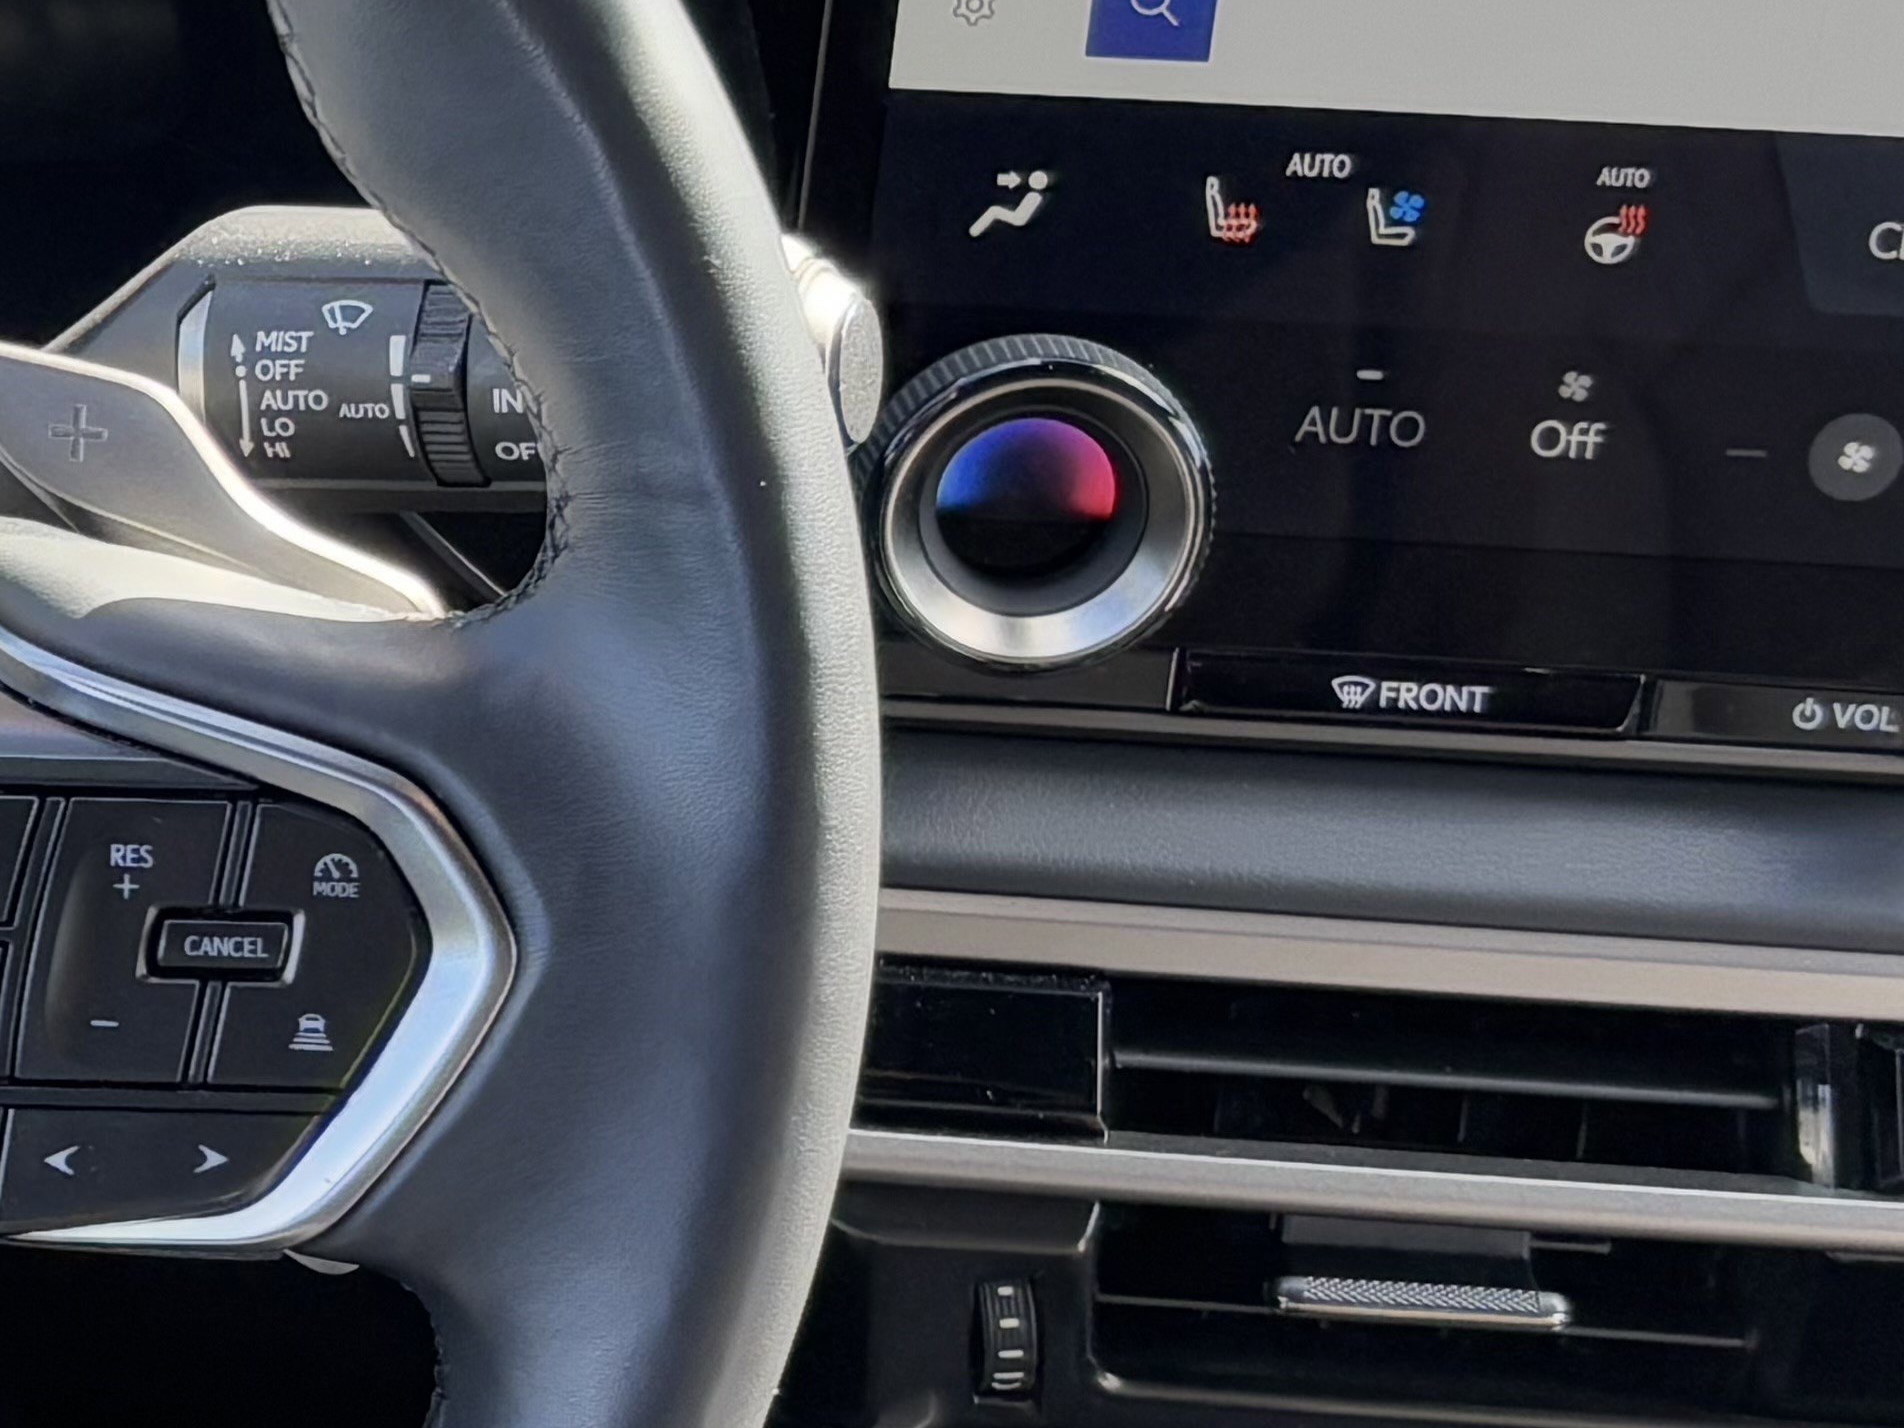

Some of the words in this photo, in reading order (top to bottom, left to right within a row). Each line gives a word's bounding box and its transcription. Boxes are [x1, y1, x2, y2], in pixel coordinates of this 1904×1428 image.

[1285, 152, 1352, 179] AUTO
[1596, 166, 1651, 189] AUTO
[255, 330, 314, 353] MIST
[254, 358, 305, 382] OFF
[260, 388, 329, 411] AUTO
[339, 402, 391, 419] AUTO
[492, 386, 525, 413] IN
[260, 416, 296, 437] LO
[1294, 405, 1426, 448] AUTO
[263, 441, 291, 458] HI
[495, 441, 537, 461] OF
[1530, 419, 1607, 460] Off
[1379, 680, 1491, 713] FRONT
[1832, 702, 1899, 733] VOL
[110, 843, 154, 868] RES
[312, 878, 359, 898] MODE
[184, 935, 269, 958] CANCEL
